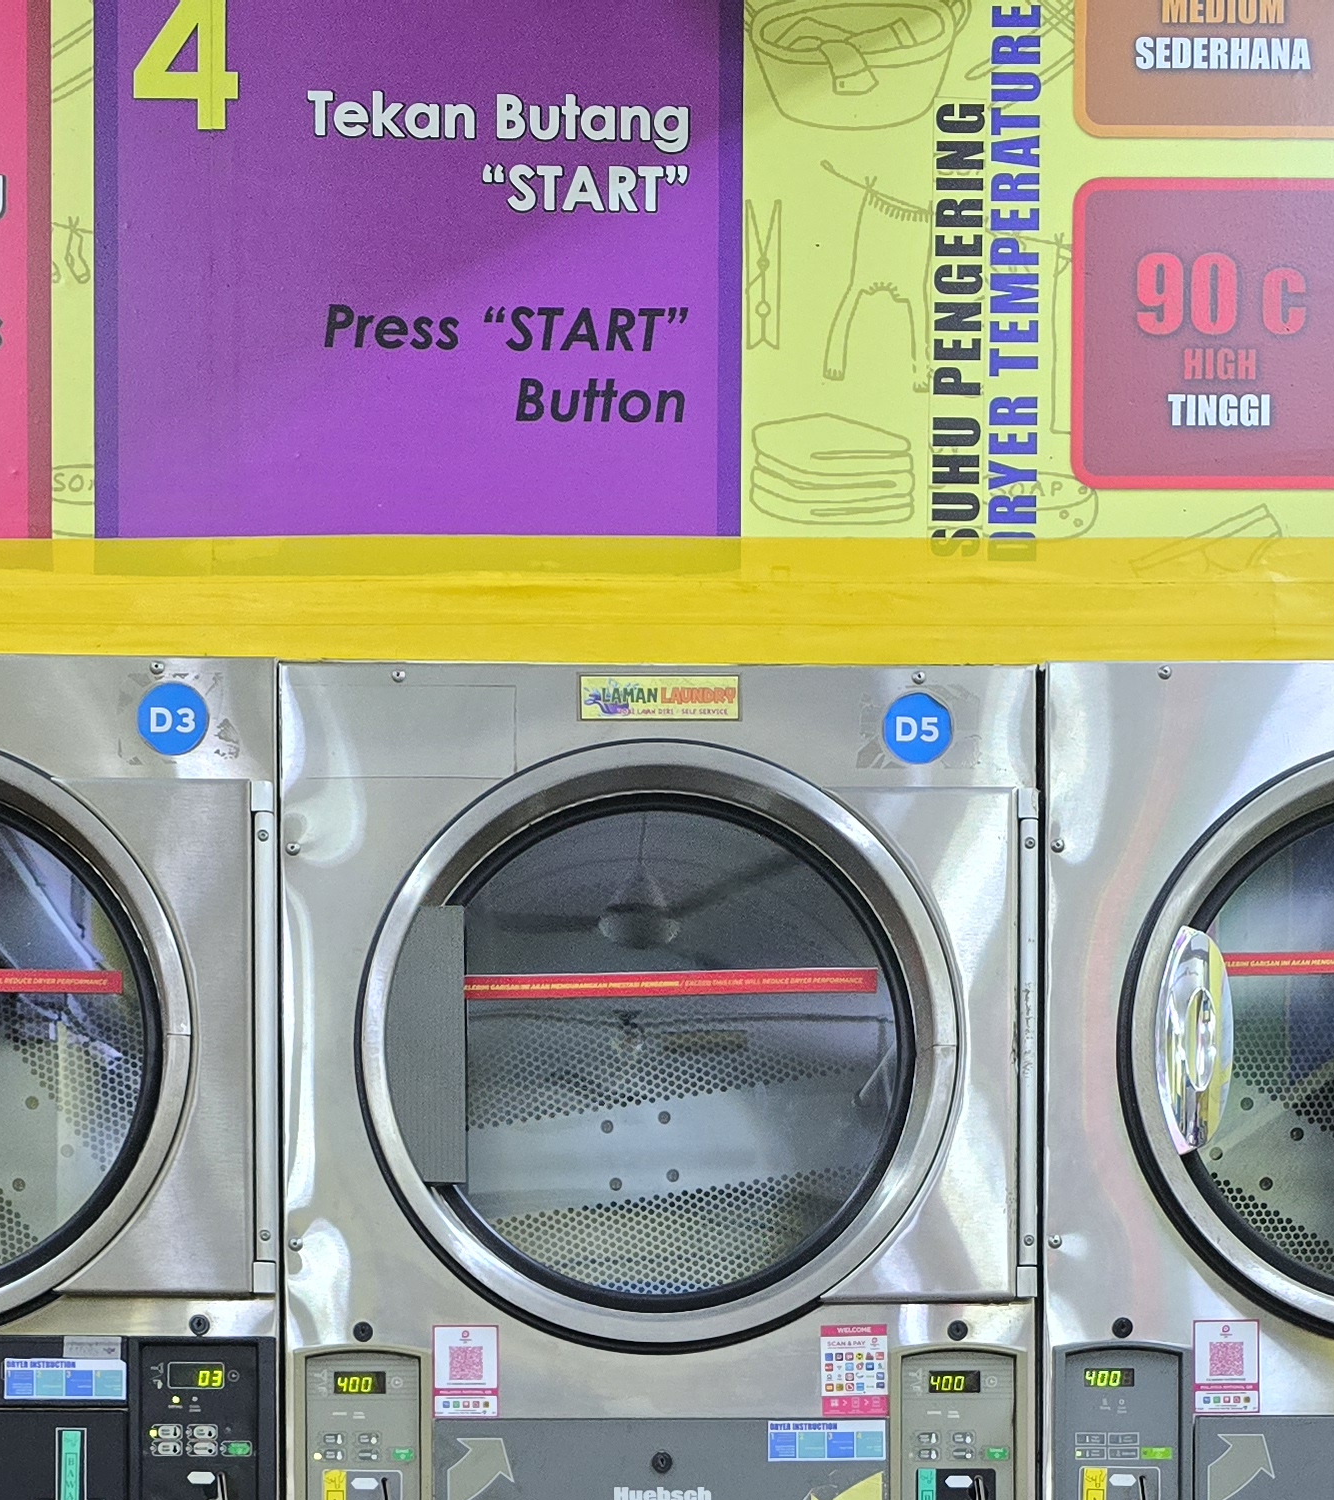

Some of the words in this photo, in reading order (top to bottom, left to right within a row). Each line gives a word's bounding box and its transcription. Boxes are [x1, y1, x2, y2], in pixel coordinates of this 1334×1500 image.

[1160, 0, 1285, 25] MEDIUM
[132, 0, 239, 132] 4
[1134, 36, 1312, 71] SEDERHANA
[307, 89, 476, 141] Tekan
[495, 92, 691, 149] Butang
[989, 4, 1042, 379] TEMPERATURE
[933, 102, 985, 398] PENGERING
[1135, 251, 1238, 336] 90
[324, 304, 461, 352] Press
[1183, 348, 1257, 382] HIGH
[515, 377, 687, 426] Button
[1167, 393, 1271, 427] TINGGI
[930, 416, 983, 557] SUHU
[987, 395, 1039, 562] DRYER
[602, 687, 658, 704] LAMAN
[660, 686, 736, 705] LAUNDRY
[151, 706, 196, 733] D3
[896, 716, 939, 742] D5
[198, 1370, 223, 1387] 03
[337, 1376, 372, 1392] 400
[930, 1376, 965, 1391] 400
[1085, 1370, 1121, 1386] 400
